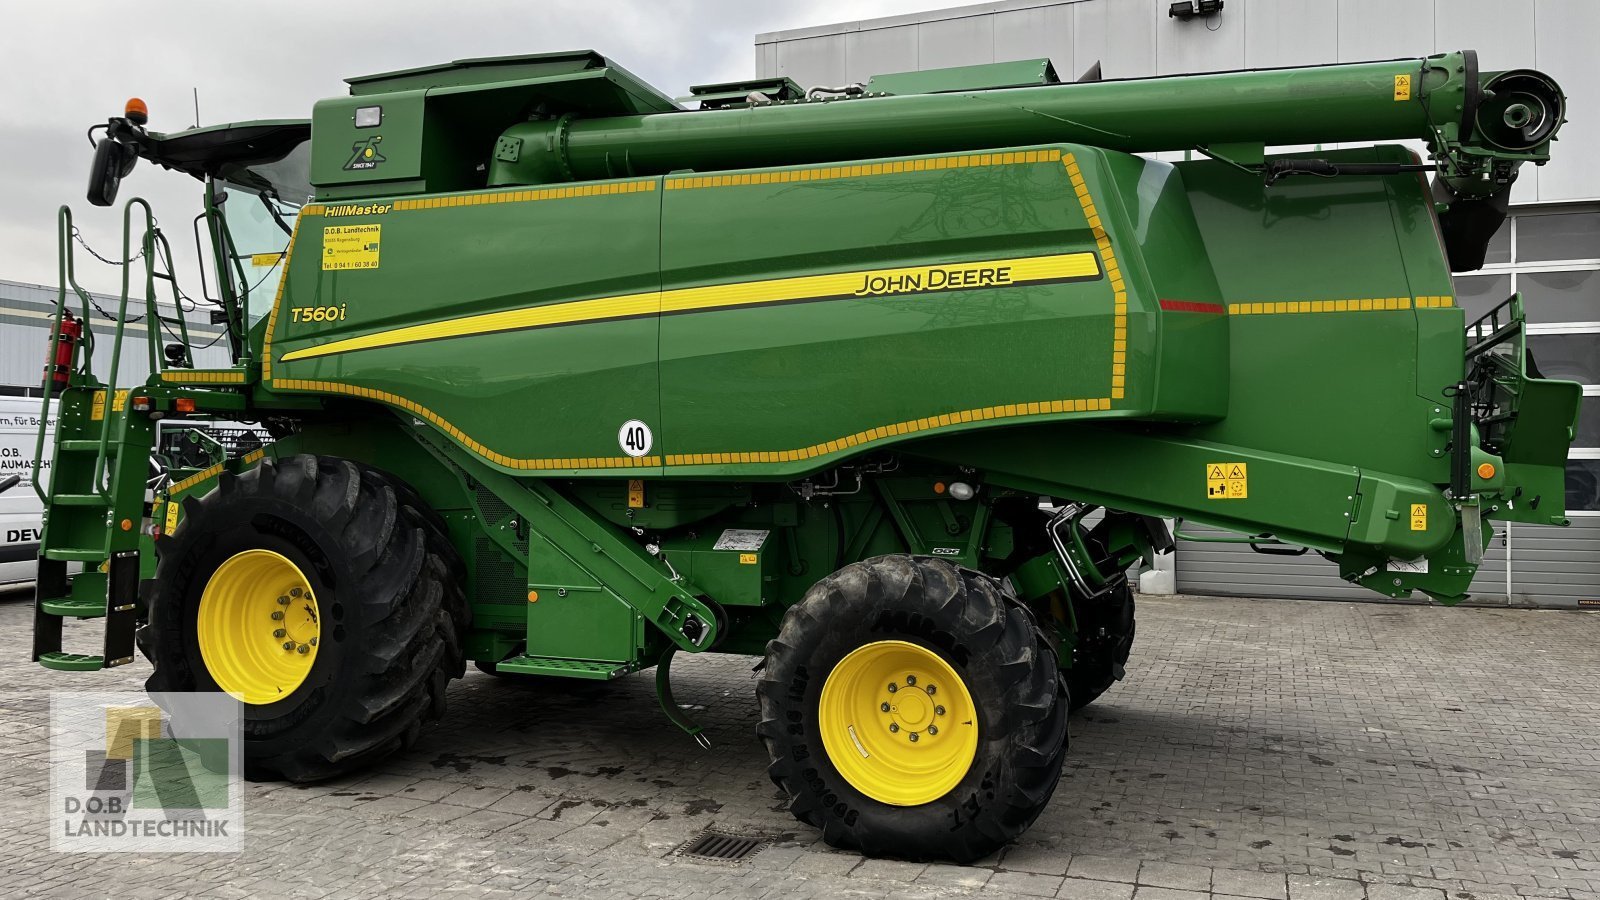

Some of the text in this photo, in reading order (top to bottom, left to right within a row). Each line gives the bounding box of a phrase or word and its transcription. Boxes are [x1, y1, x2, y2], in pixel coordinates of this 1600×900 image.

[324, 204, 392, 218] HillMaster
[855, 267, 1012, 294] JOHN DEERE
[291, 303, 347, 323] T560i
[14, 416, 28, 426] für
[626, 427, 645, 450] 40
